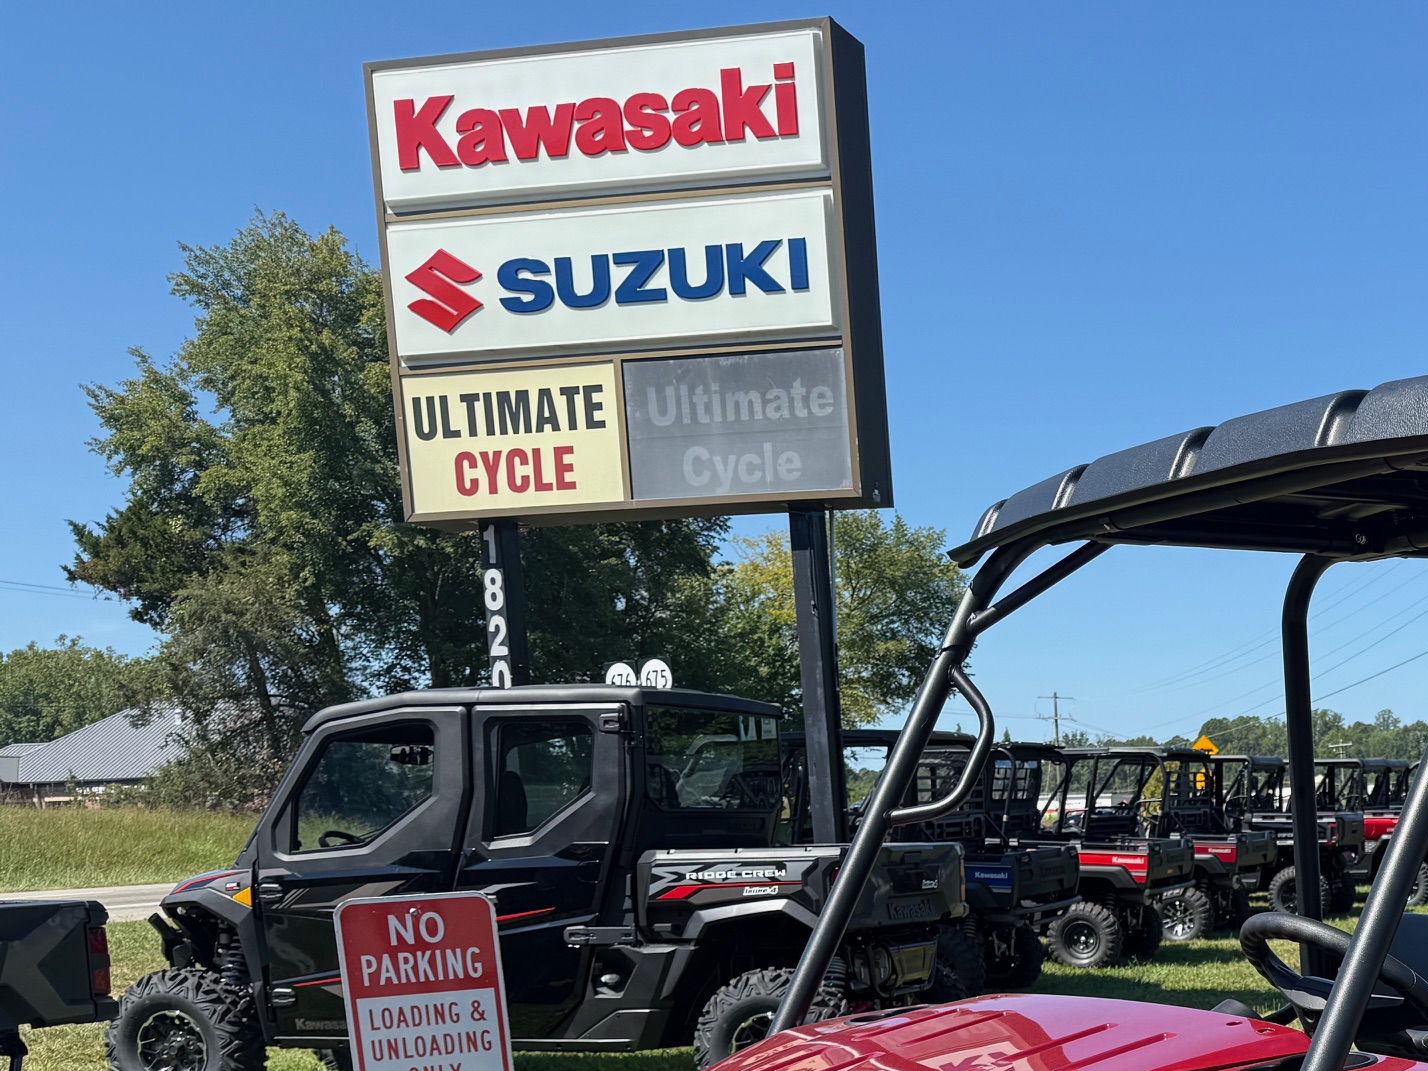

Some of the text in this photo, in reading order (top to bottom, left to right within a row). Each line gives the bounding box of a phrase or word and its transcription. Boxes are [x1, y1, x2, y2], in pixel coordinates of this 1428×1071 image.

[393, 62, 799, 170] Kawasaki
[496, 237, 809, 313] SUZUKI
[411, 384, 606, 441] ULTIMATE
[646, 383, 834, 428] Ultimate
[454, 446, 577, 497] CYCLE
[683, 442, 802, 494] Cycle
[645, 669, 668, 688] 675
[686, 869, 786, 880] RIDGE CREW
[974, 871, 1008, 879] Kawasaki
[887, 898, 934, 920] Kawasaki
[387, 911, 445, 946] NO
[360, 946, 483, 987] PARKING
[294, 1018, 347, 1030] Kawasa
[368, 1000, 487, 1031] LOADING &
[370, 1029, 493, 1062] UNLOADING
